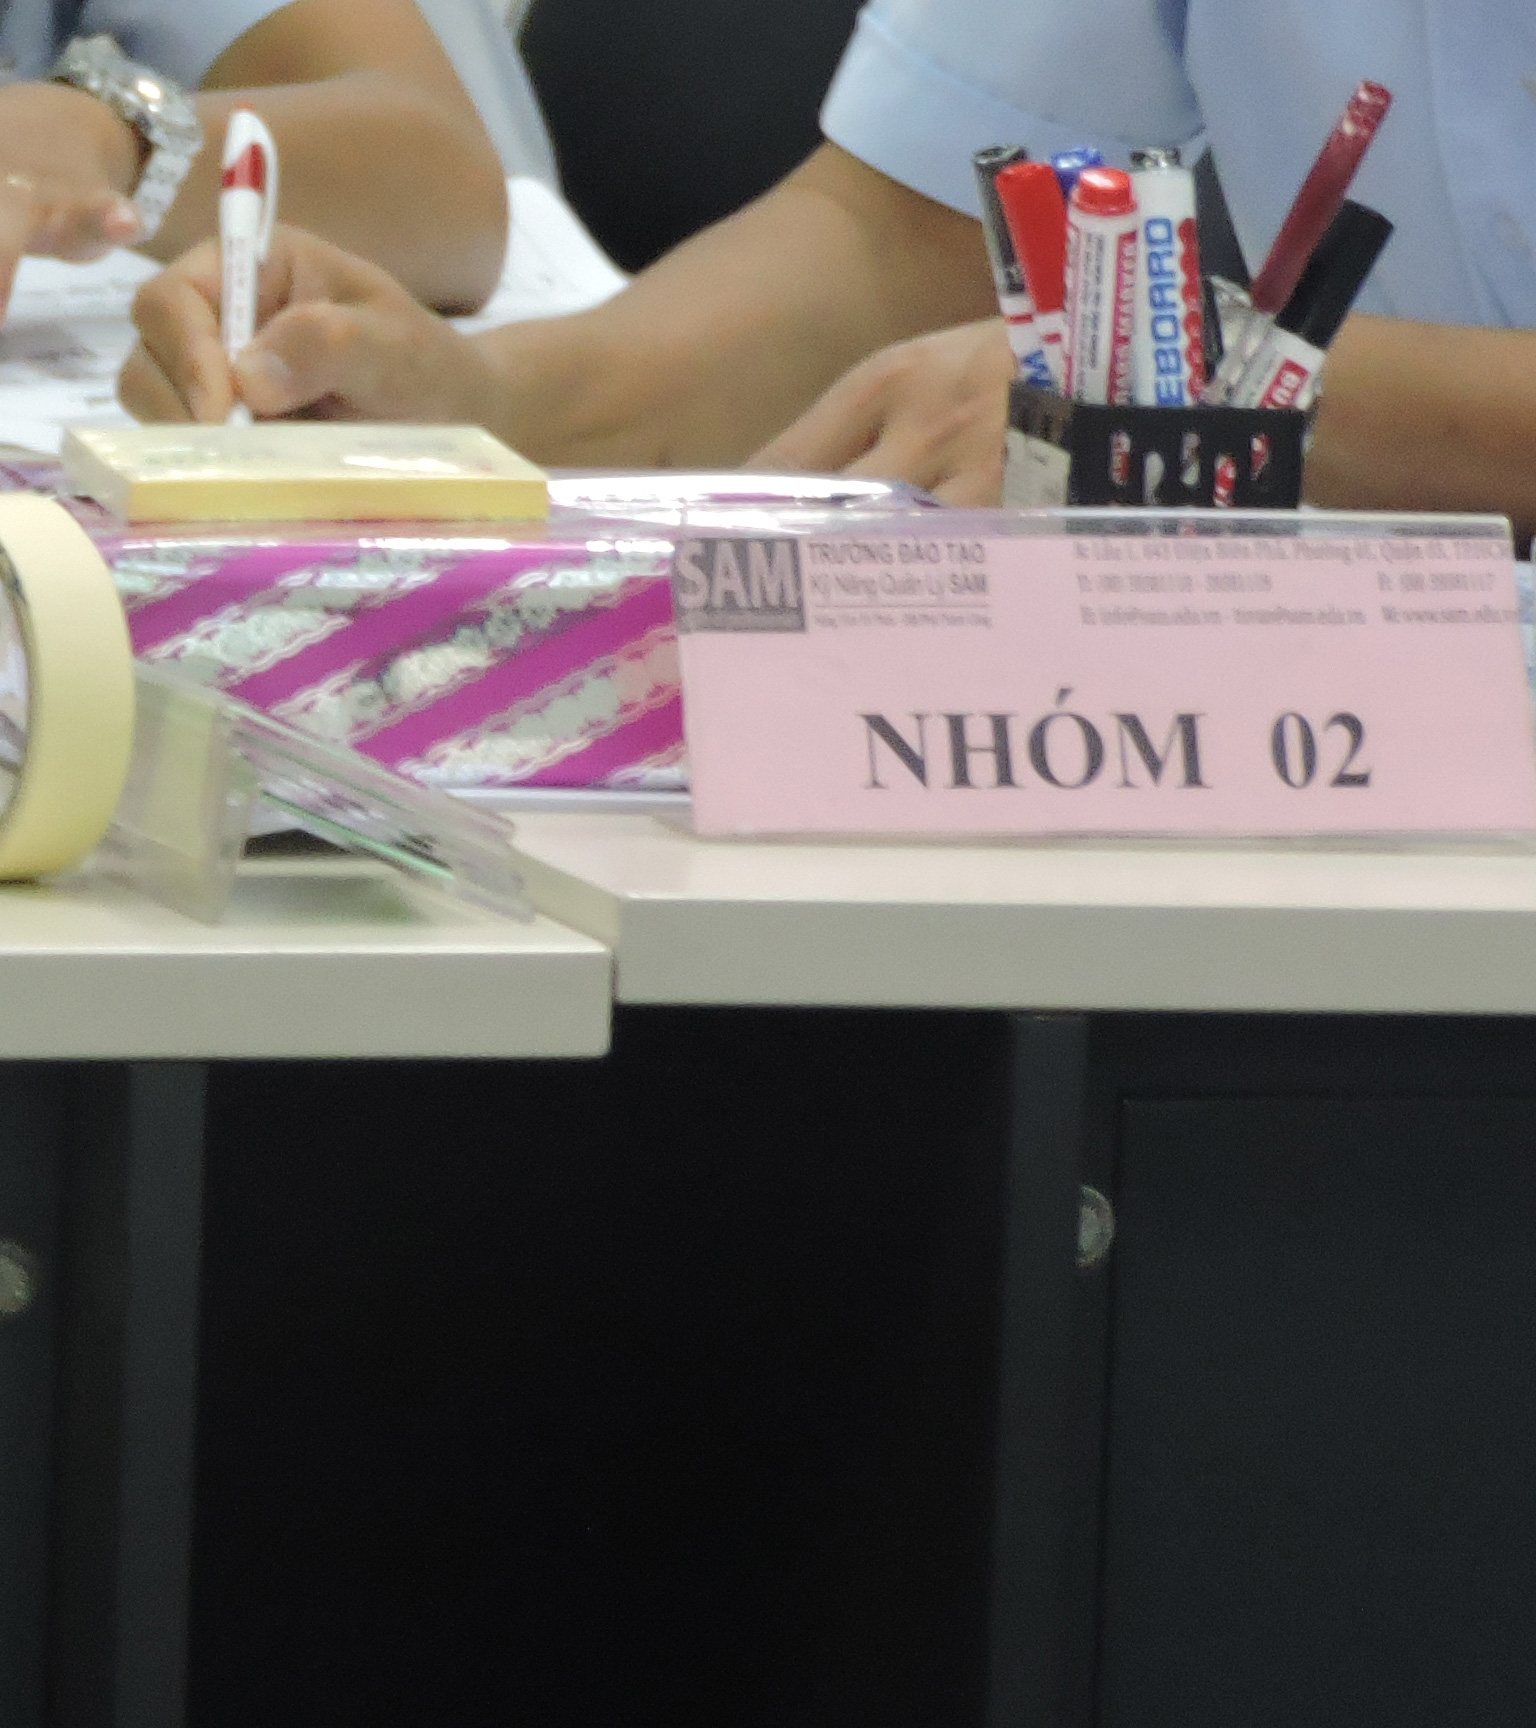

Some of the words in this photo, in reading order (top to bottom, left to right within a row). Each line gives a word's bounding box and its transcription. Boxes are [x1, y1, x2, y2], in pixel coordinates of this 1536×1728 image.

[678, 539, 799, 610] SAM
[949, 572, 989, 595] SAM
[860, 686, 1213, 790] NHÓM
[1269, 710, 1373, 790] 02
